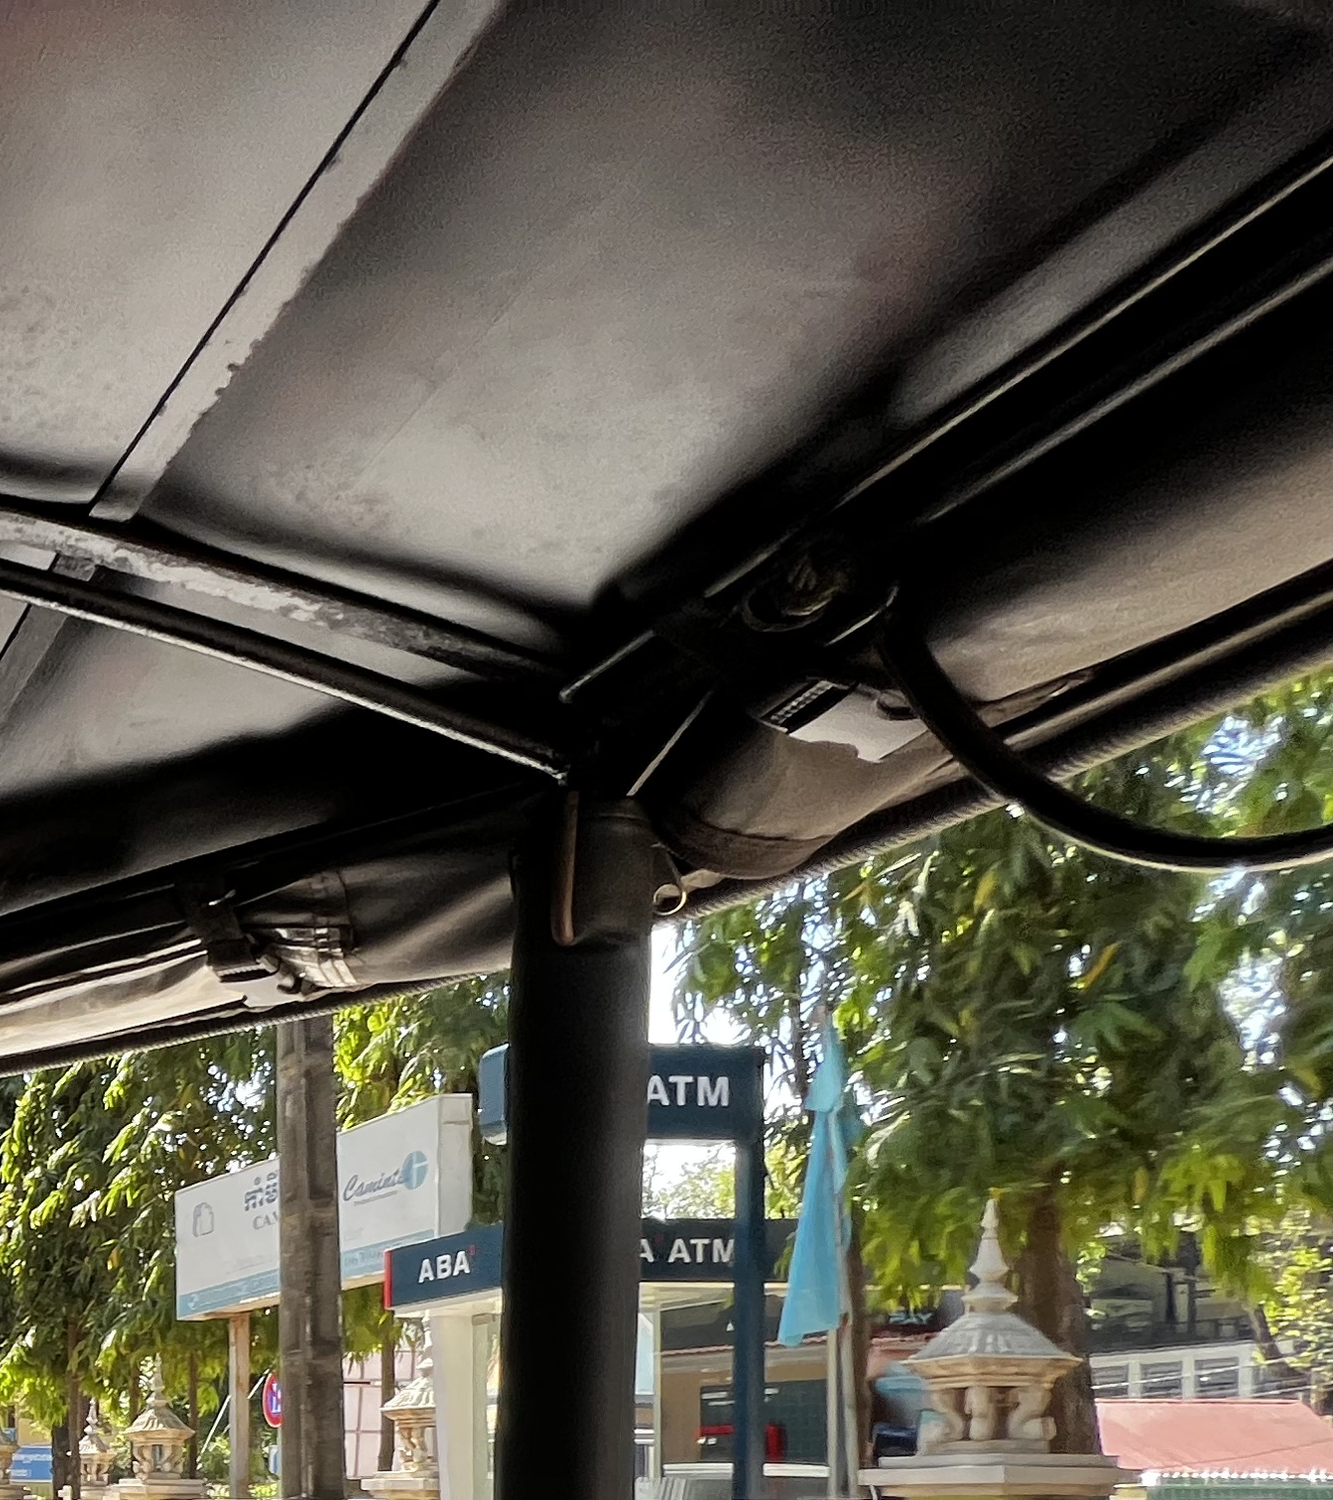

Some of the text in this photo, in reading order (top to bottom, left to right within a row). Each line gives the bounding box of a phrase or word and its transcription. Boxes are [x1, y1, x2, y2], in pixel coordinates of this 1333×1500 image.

[647, 1075, 730, 1107] ATM
[666, 1238, 735, 1263] ATM
[418, 1251, 471, 1284] ABA
